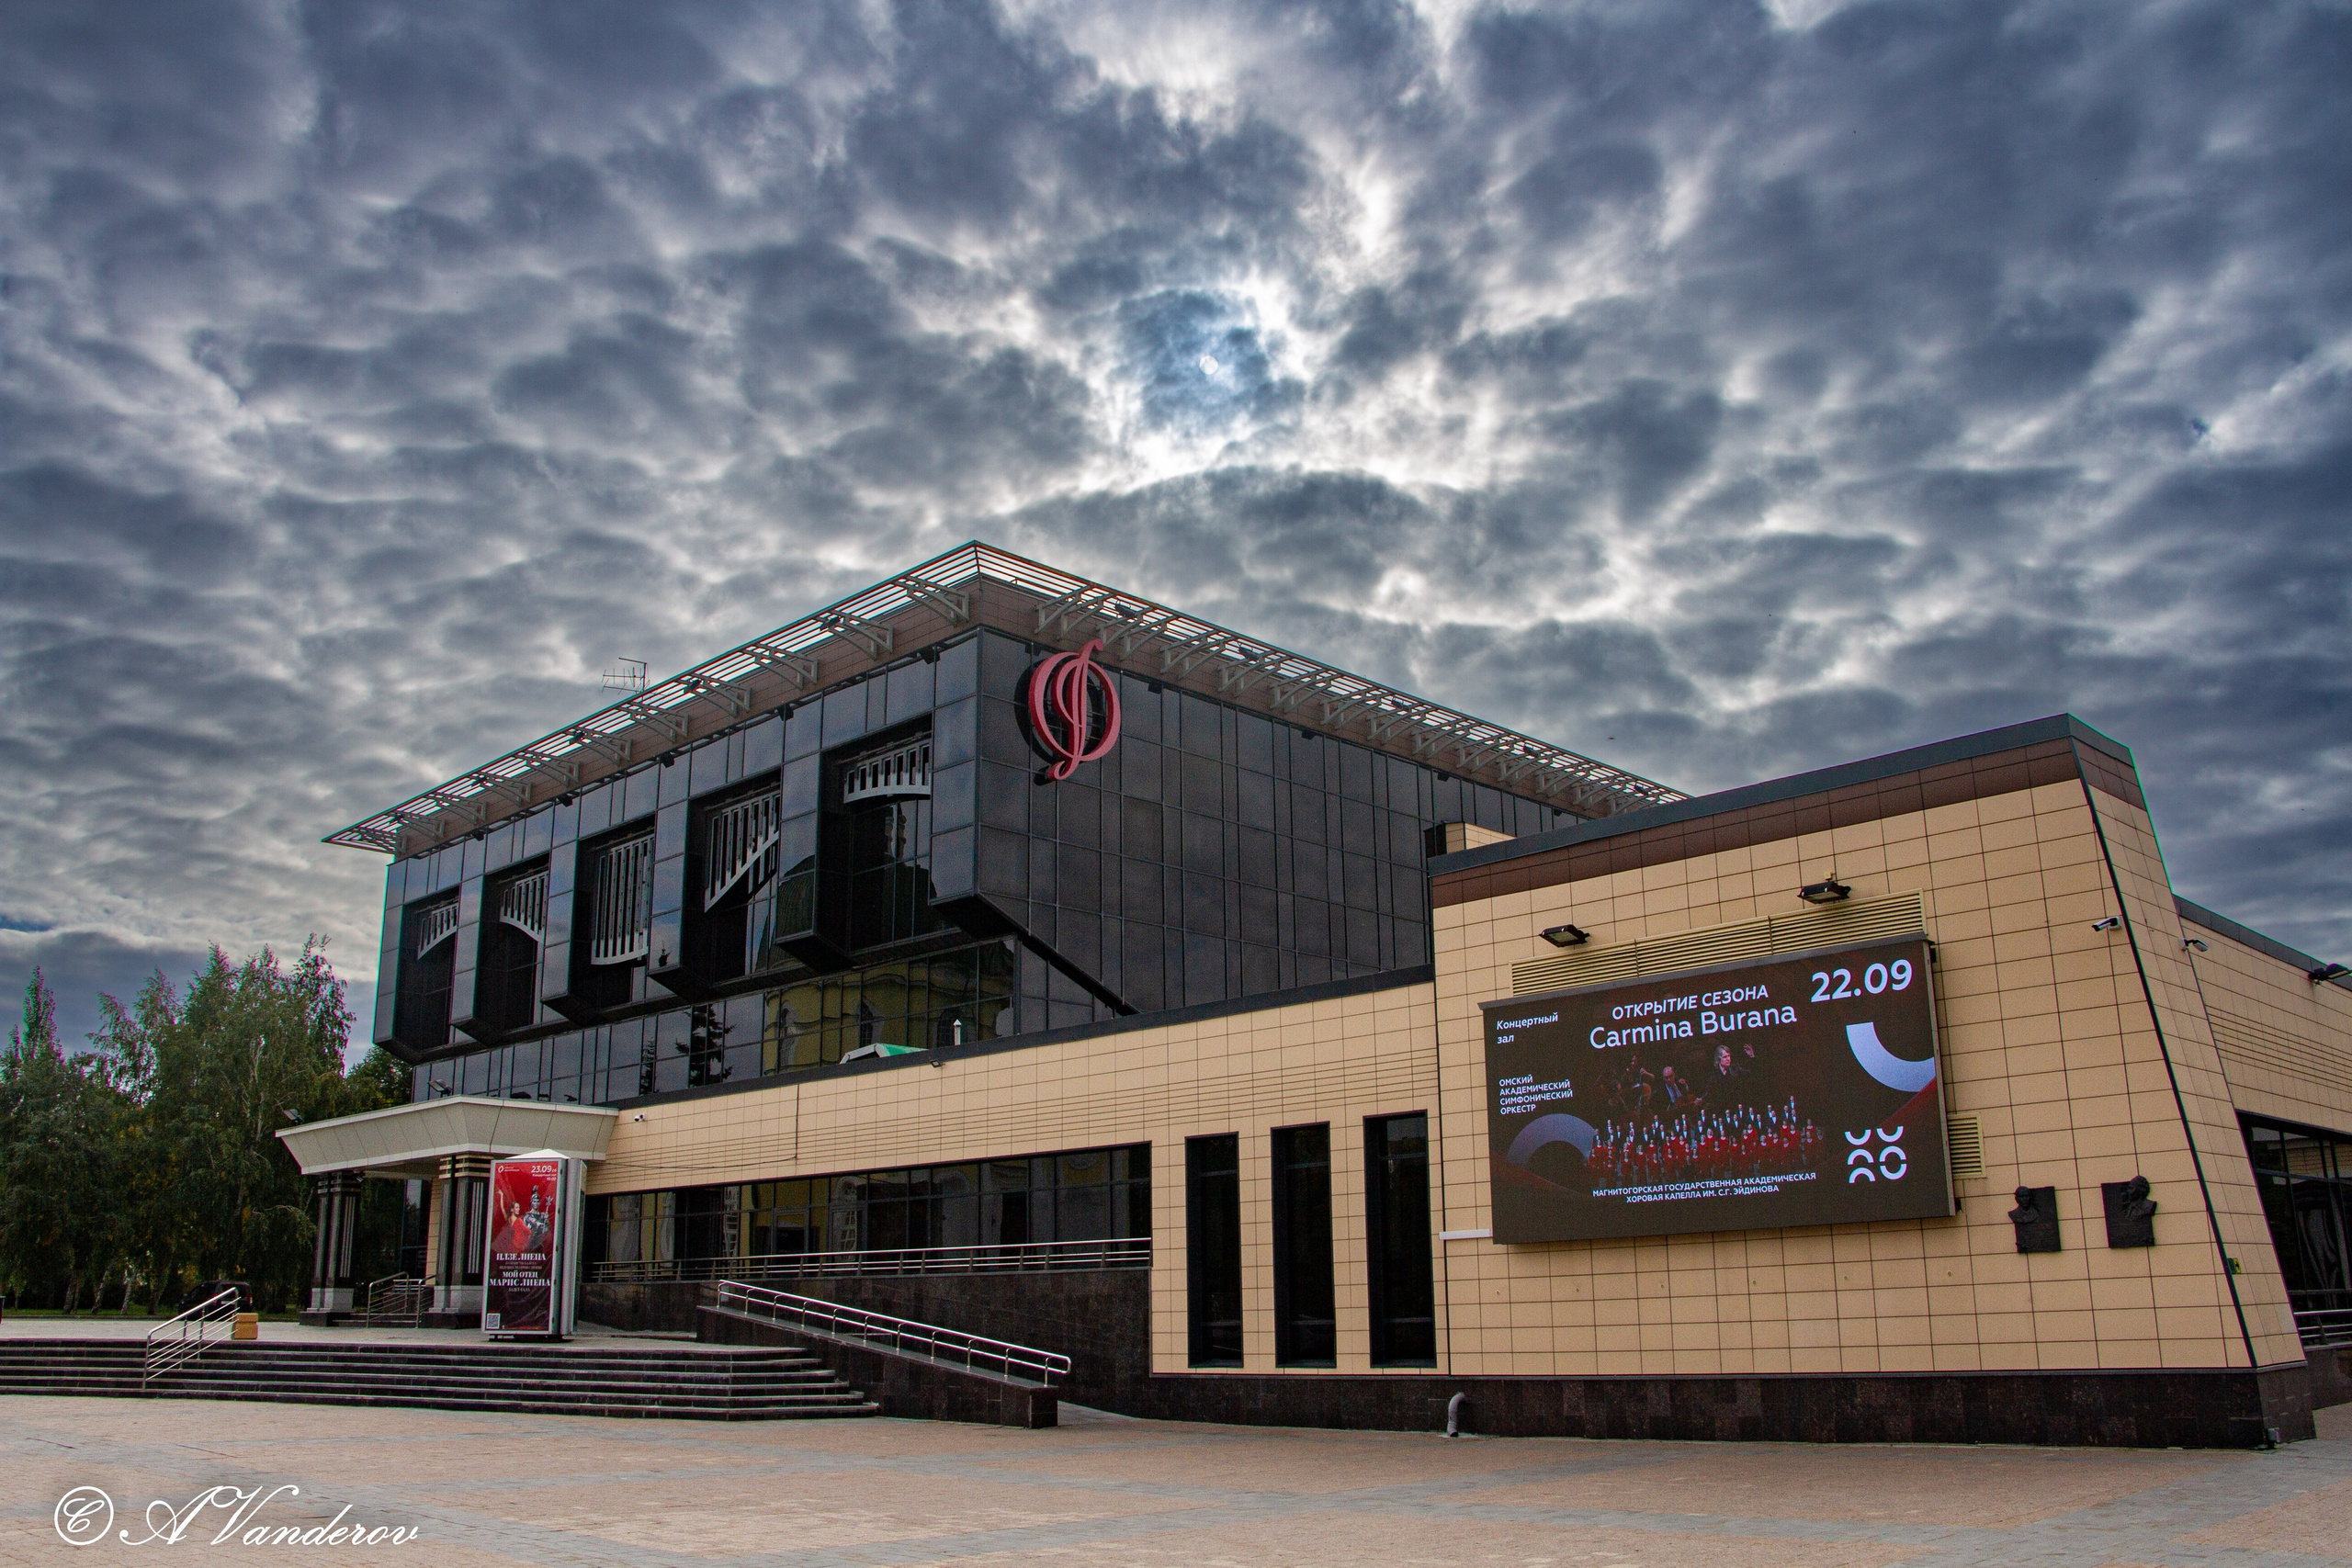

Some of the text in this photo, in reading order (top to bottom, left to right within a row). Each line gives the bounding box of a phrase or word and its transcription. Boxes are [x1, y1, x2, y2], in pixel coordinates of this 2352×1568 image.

[1811, 958, 1913, 1003] 22.09
[1611, 984, 1770, 1021] ОТКРЫТИЕ СЕЗОНА
[1497, 1011, 1559, 1031] Концертный
[1589, 1005, 1797, 1049] Carmina Burana
[1497, 1033, 1515, 1044] зал
[1498, 1074, 1533, 1088] ОМСКИЙ
[1499, 1078, 1571, 1096] АКАДЕМИЧЕСКИЙ
[1499, 1089, 1574, 1106] СИМФОНИЧЕСКИЙ
[1500, 1103, 1537, 1115] ОРКЕСТР
[531, 1165, 552, 1173] 23.09
[1592, 1172, 1816, 1197] МАГНИТОГОРСКАЯ ГОСУДАРСТВЕННАЯ АКАДЕМИЧЕСКАЯ
[1626, 1184, 1780, 1203] ХОРОВАЯ КАПЕЛЛА ИМ. С.Г. ЭЙДИНОВА
[503, 1269, 518, 1278] МОЙ
